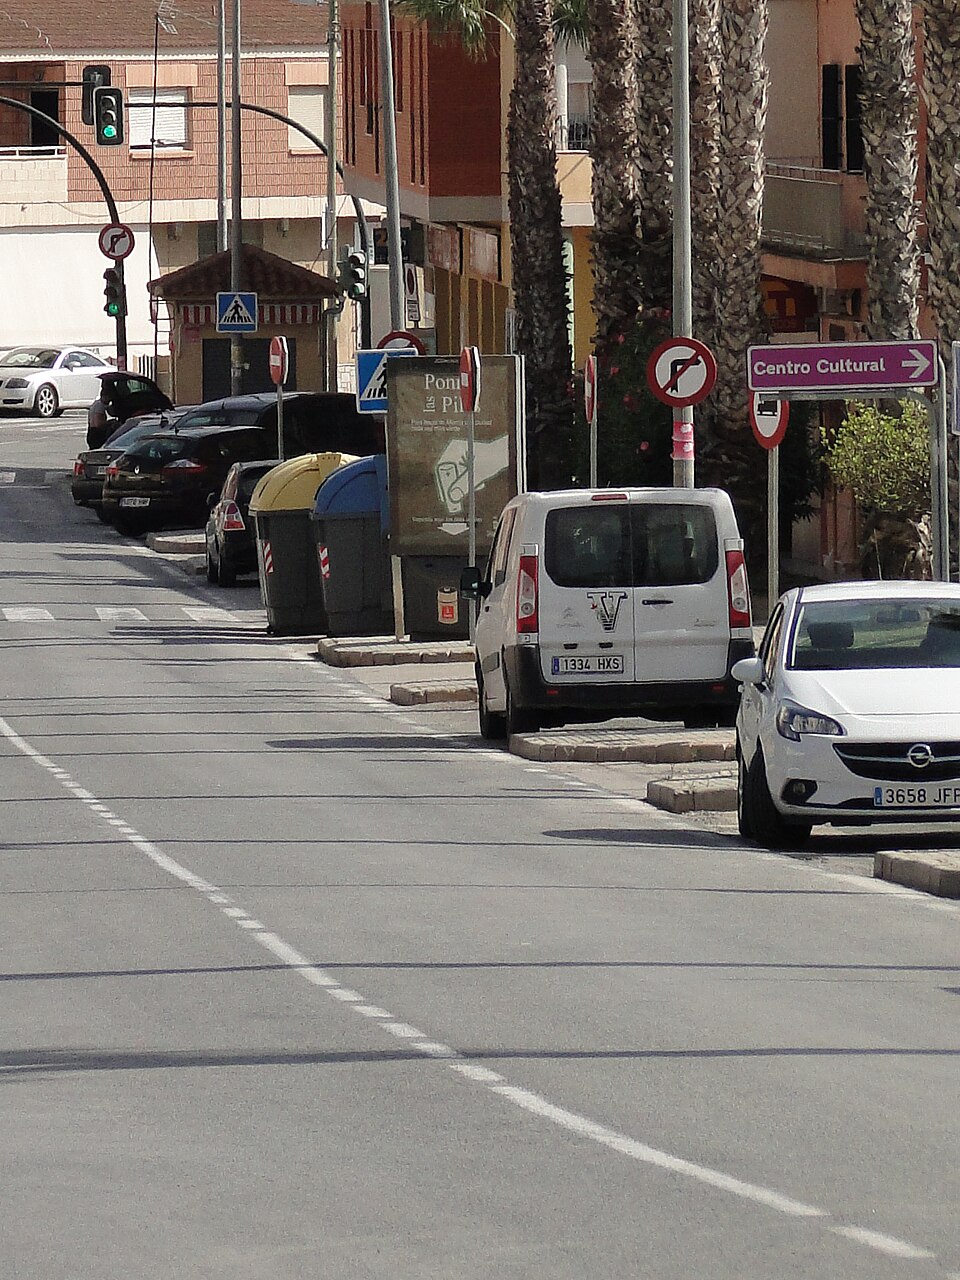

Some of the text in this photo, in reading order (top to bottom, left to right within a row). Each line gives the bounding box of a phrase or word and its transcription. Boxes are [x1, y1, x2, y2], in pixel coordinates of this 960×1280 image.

[753, 358, 886, 375] Centro Cultural
[442, 396, 481, 413] Pil
[563, 658, 620, 671] 1334 HXS
[885, 788, 927, 803] 3658
